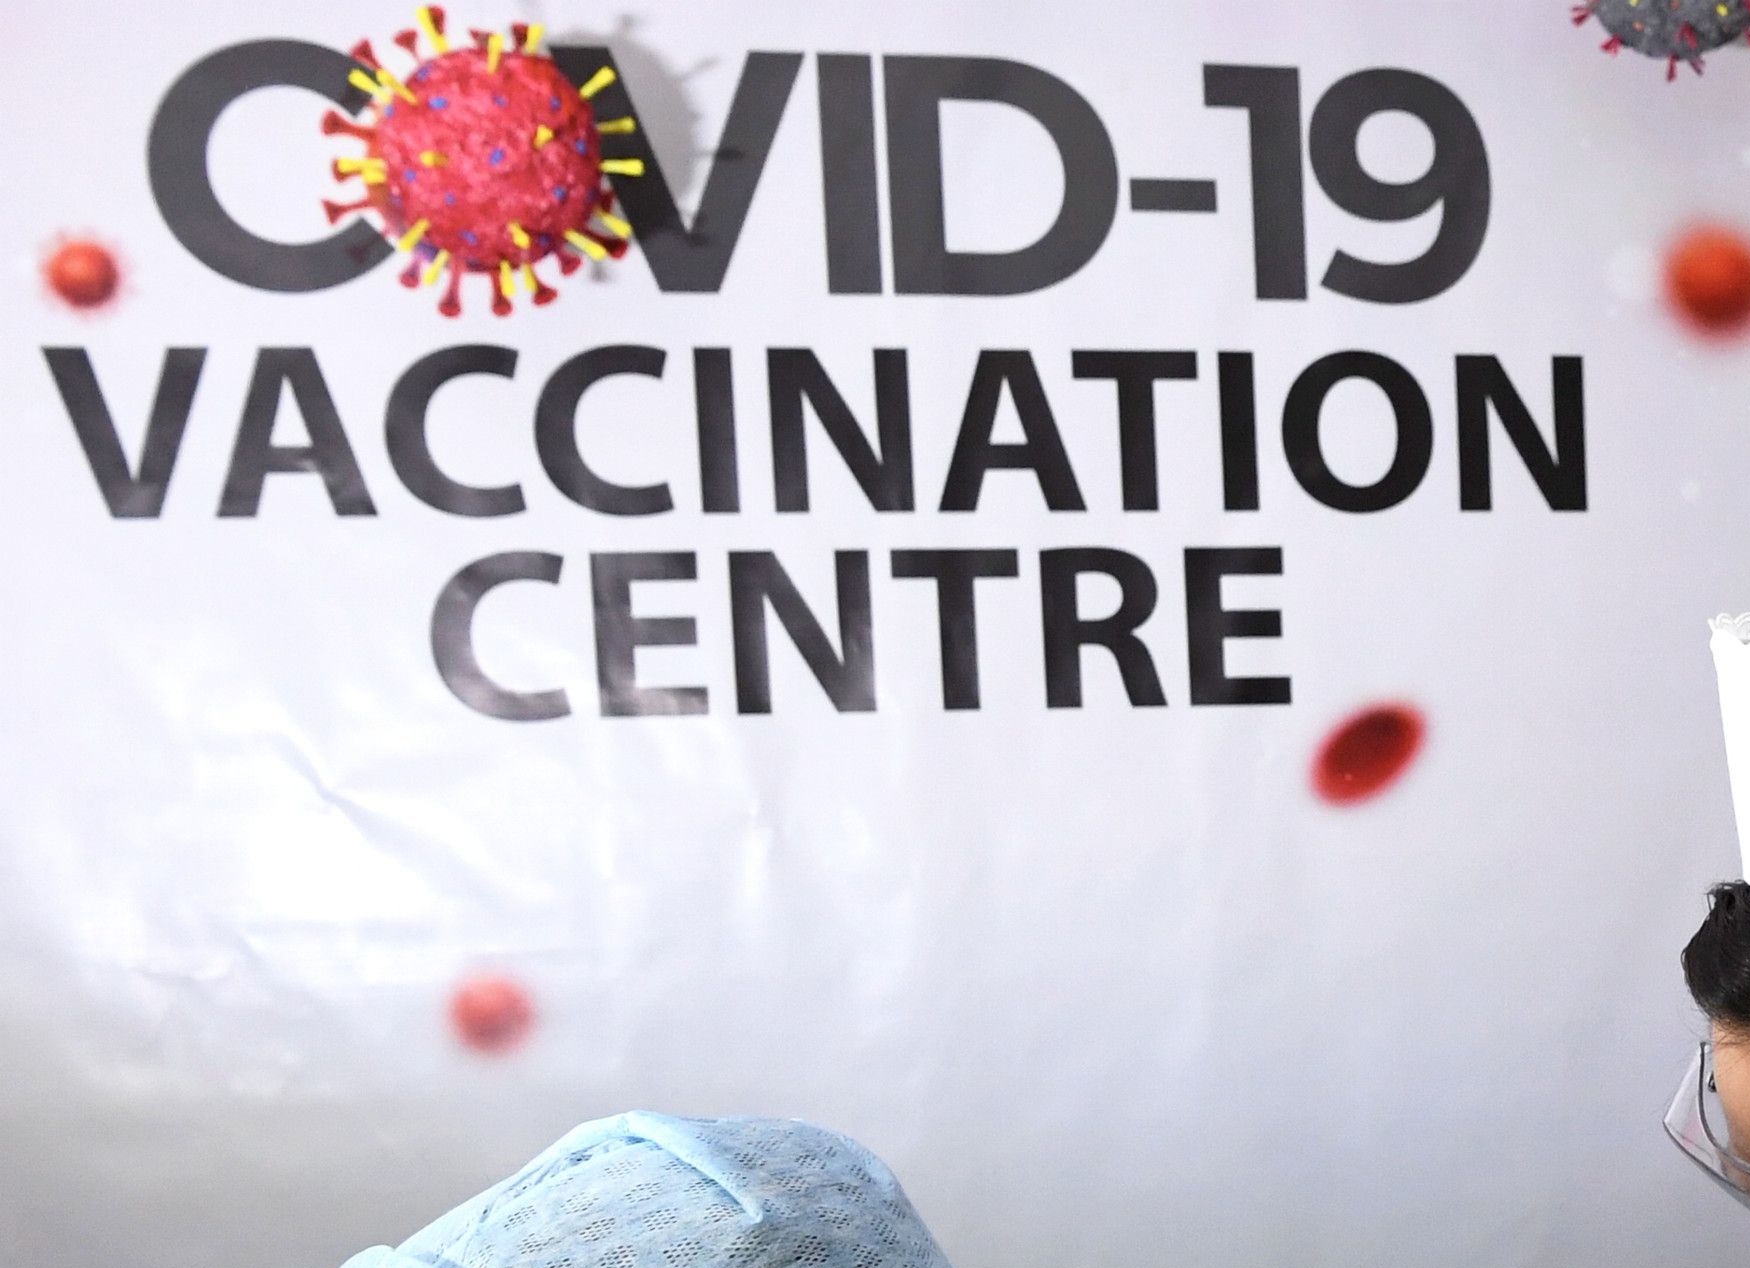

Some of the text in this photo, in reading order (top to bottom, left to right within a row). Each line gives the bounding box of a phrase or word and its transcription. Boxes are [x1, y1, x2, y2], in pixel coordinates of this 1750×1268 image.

[147, 37, 1492, 305] CVID-19
[41, 343, 1589, 519] VACCINATION
[429, 545, 1293, 723] CENTRE
